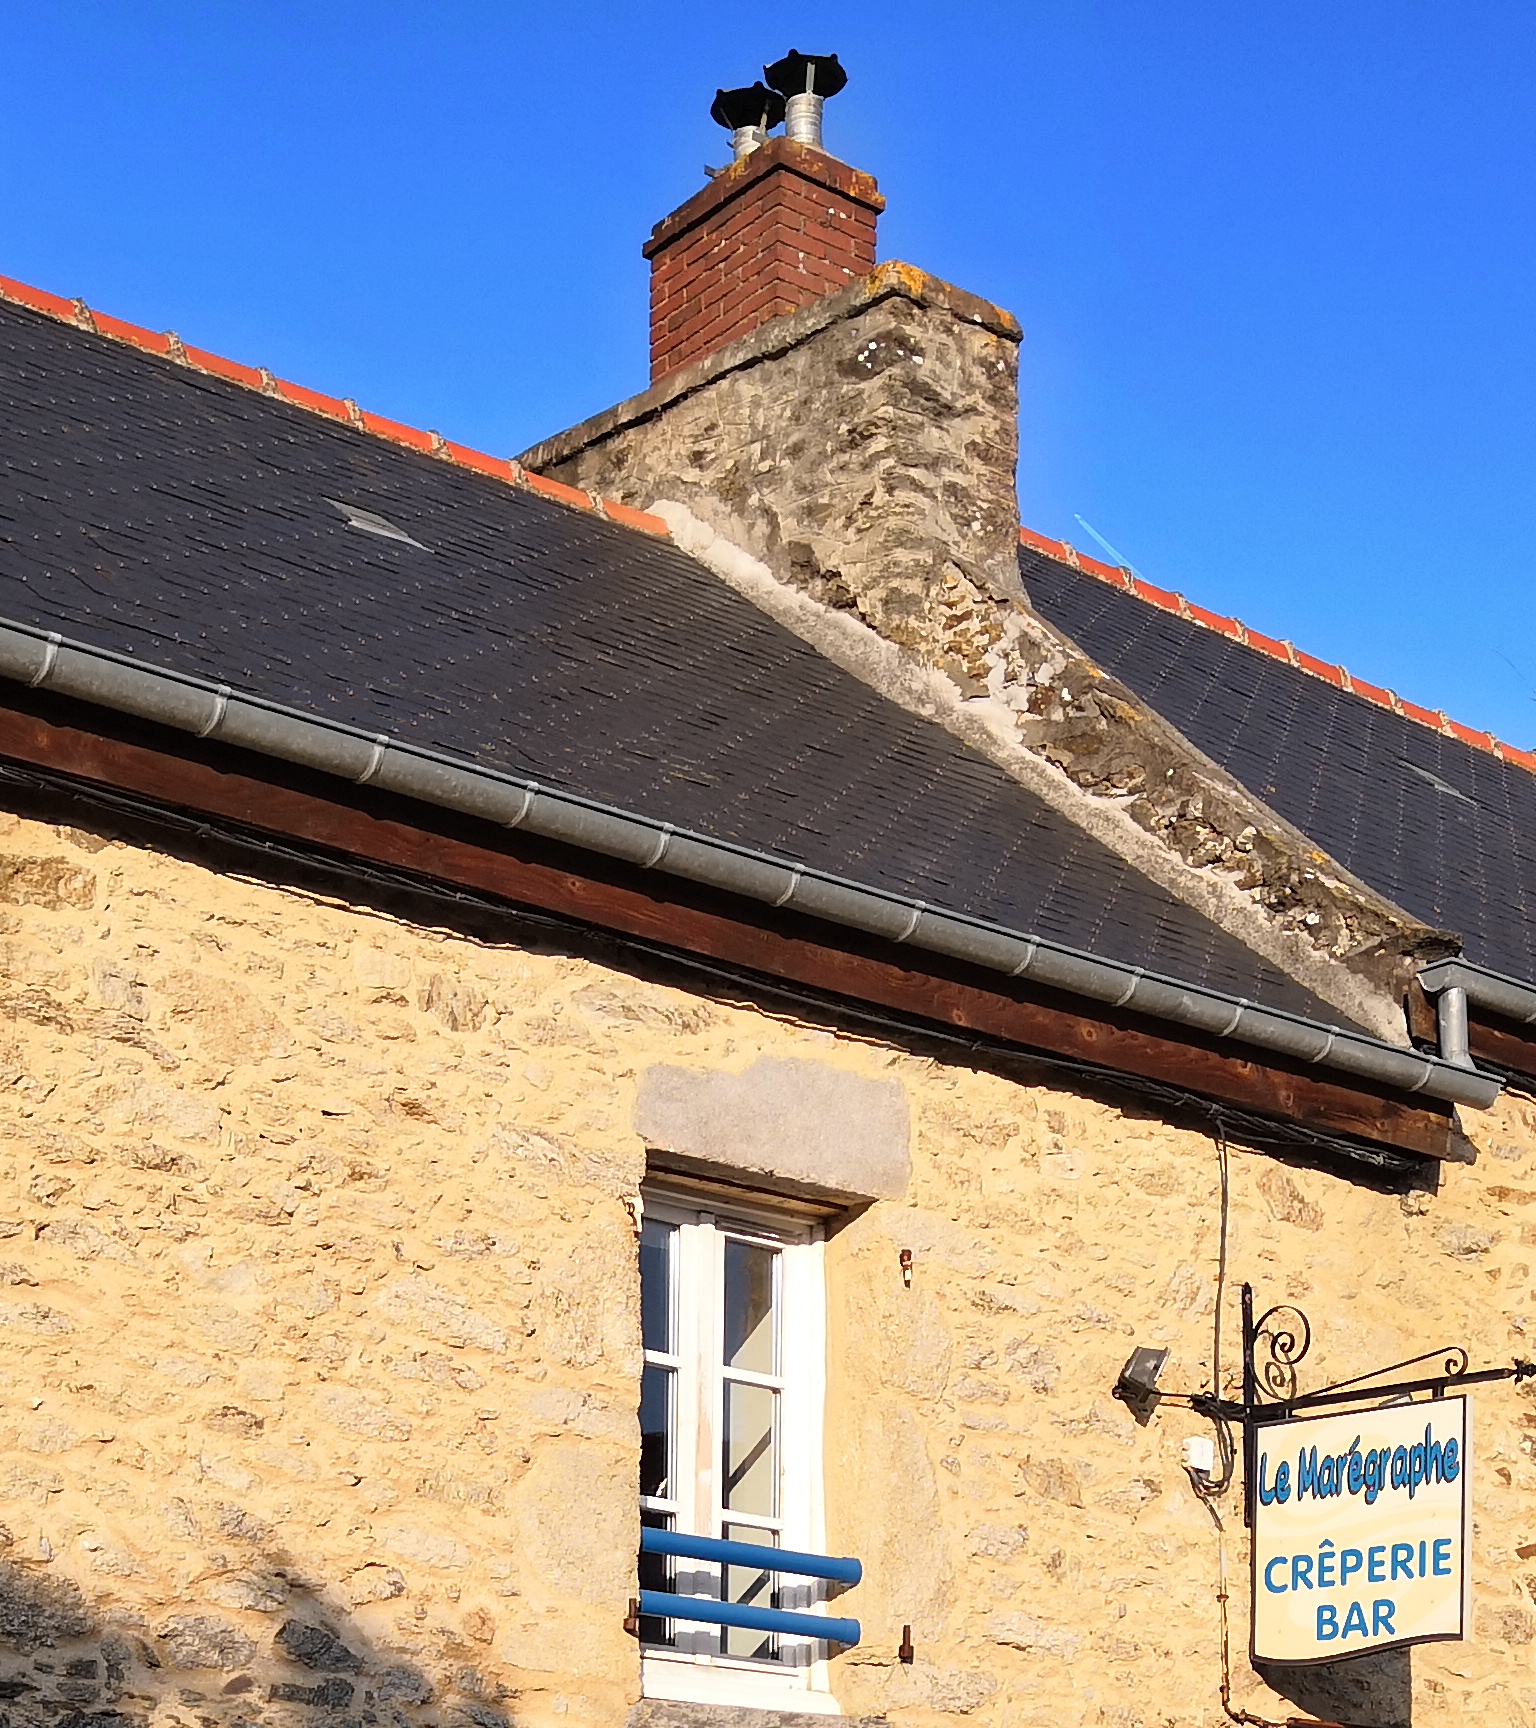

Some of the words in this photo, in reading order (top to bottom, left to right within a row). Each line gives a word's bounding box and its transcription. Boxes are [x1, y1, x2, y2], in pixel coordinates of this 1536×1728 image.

[1259, 1452, 1291, 1506] Le
[1297, 1422, 1460, 1505] Marégraphe
[1264, 1538, 1452, 1594] CRÊPERIE
[1316, 1598, 1396, 1641] BAR
